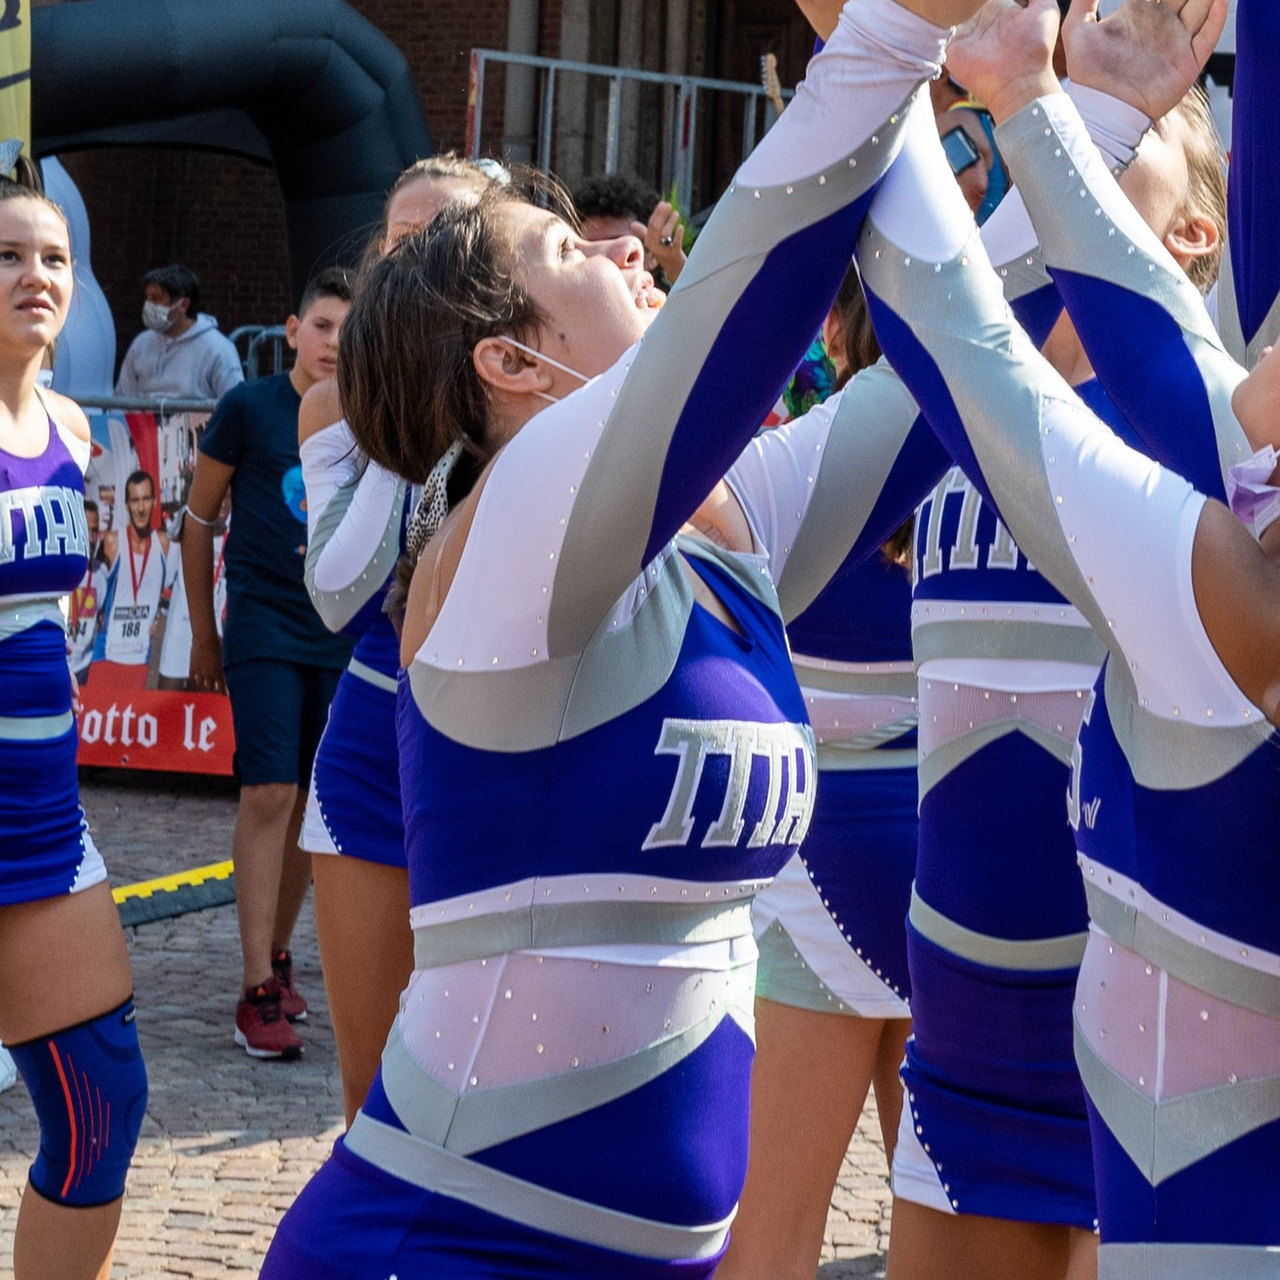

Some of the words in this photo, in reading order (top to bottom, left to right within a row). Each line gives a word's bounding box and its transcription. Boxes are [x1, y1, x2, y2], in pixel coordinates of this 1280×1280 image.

[122, 621, 141, 638] 188
[78, 702, 158, 748] otto
[183, 703, 217, 753] le
[641, 717, 818, 852] TITA
